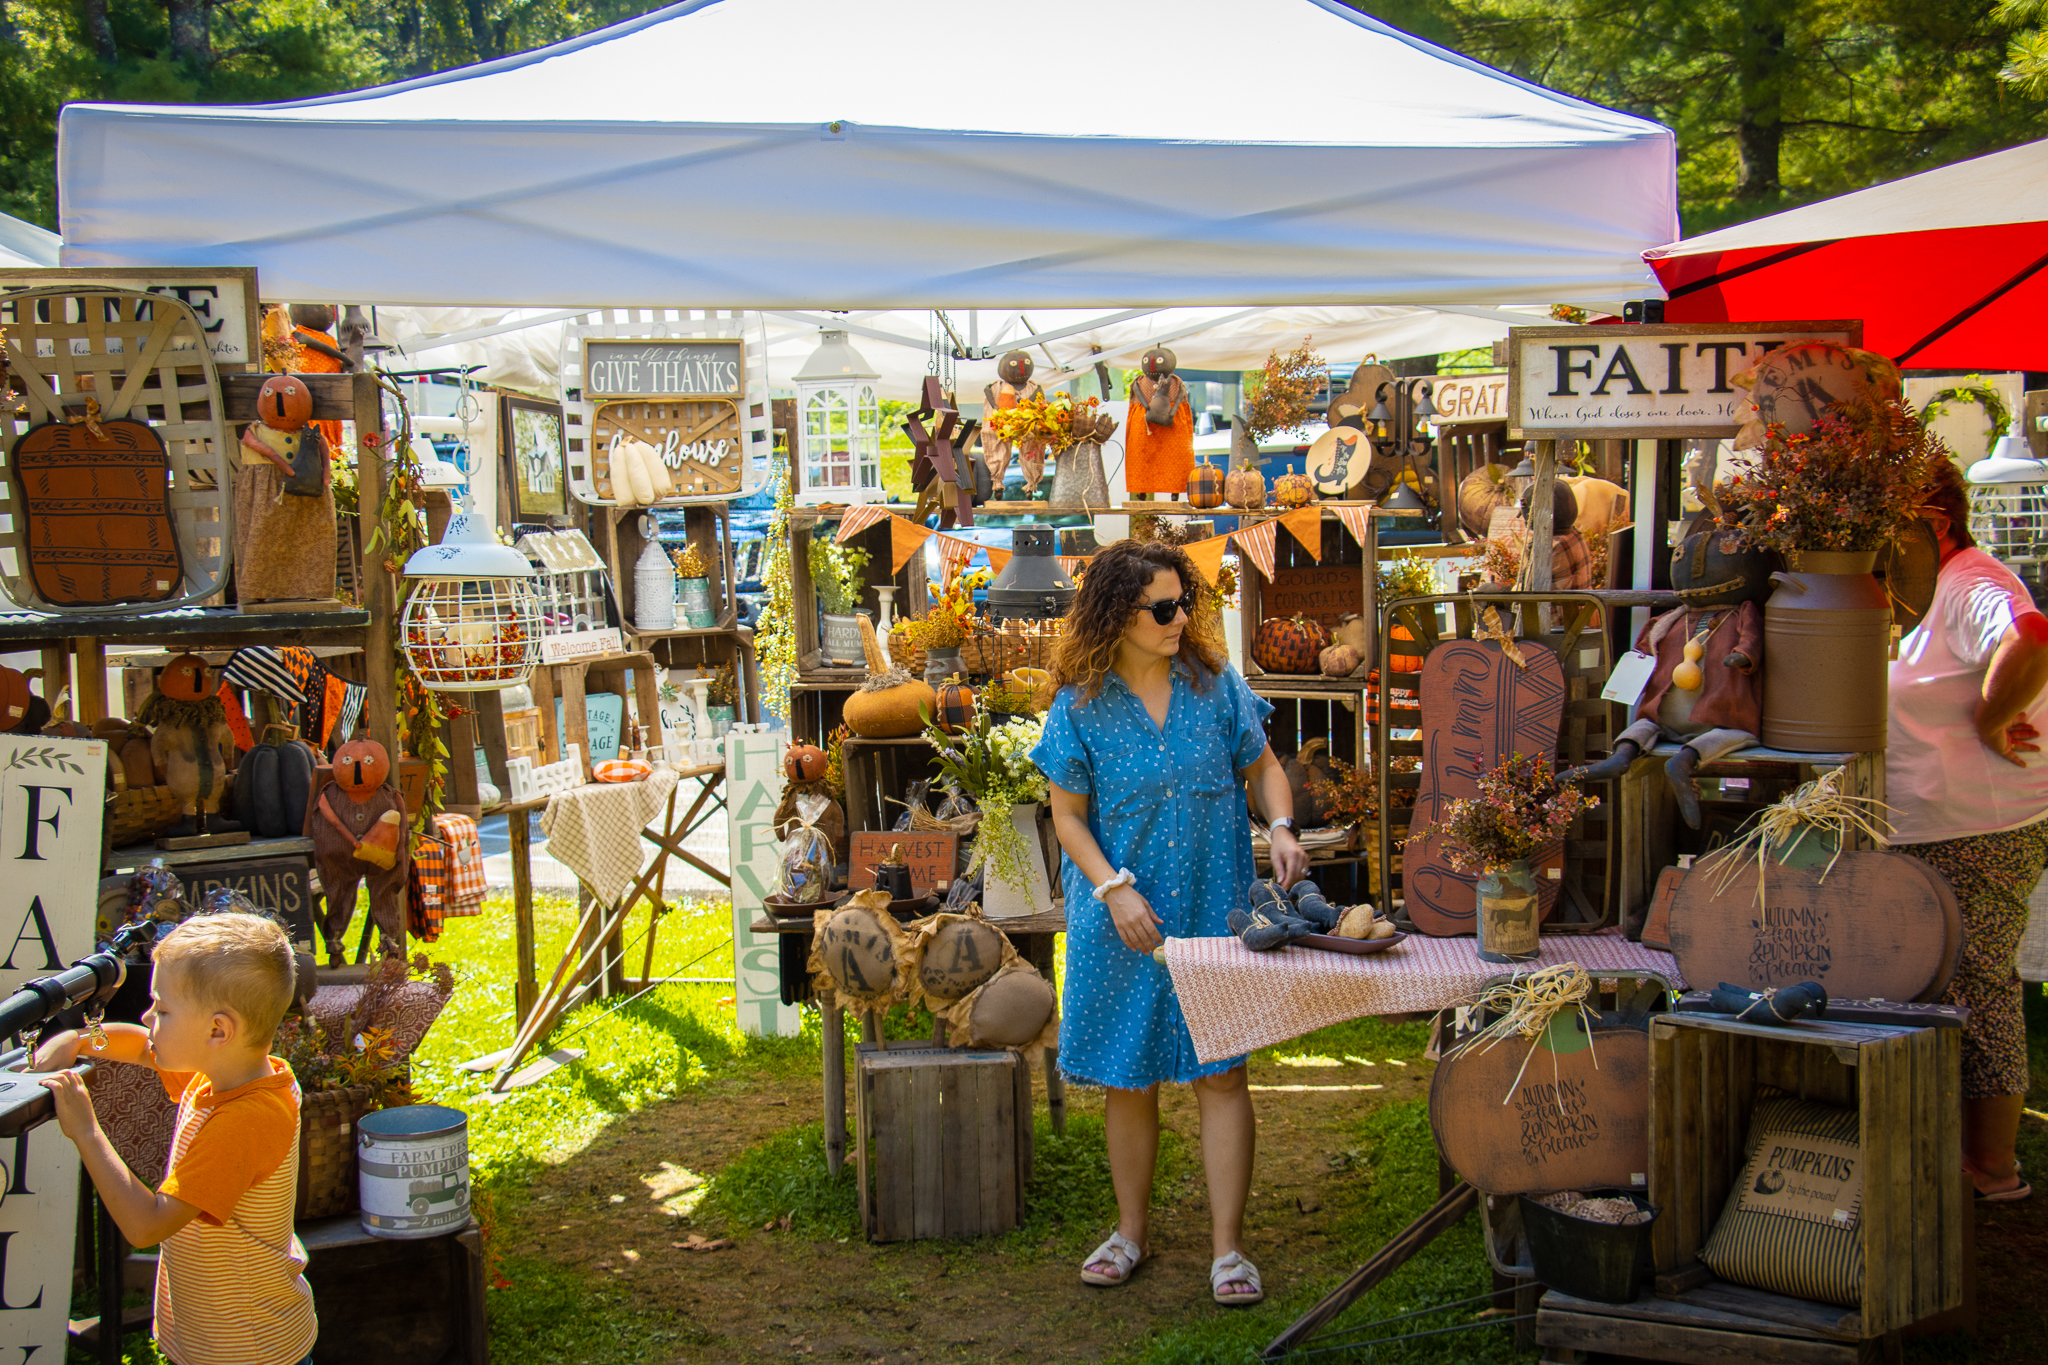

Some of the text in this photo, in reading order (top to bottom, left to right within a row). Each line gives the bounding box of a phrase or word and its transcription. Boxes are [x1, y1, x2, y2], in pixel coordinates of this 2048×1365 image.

[609, 347, 719, 365] in all things
[590, 360, 739, 393] GIVE THANKS
[1548, 341, 1786, 397] FAIT
[1437, 383, 1508, 418] GRAT
[1527, 405, 1570, 421] When
[1576, 405, 1604, 424] God
[1609, 404, 1641, 419] closes
[1647, 409, 1671, 418] one
[1277, 571, 1351, 587] GOURDS
[1274, 590, 1355, 610] CORNSTALKS
[827, 626, 861, 639] HARDY
[550, 635, 620, 657] Welcome Fall
[859, 839, 945, 859] HAVEST
[868, 863, 937, 883] TME
[181, 871, 301, 913] MPKINS
[1769, 925, 1819, 943] leaves
[1761, 959, 1819, 982] please
[1523, 1078, 1576, 1107] AUTUMN
[1533, 1099, 1580, 1122] leaves
[391, 1140, 468, 1163] FARM FRES
[1536, 1133, 1589, 1163] please
[397, 1153, 469, 1178] PUMPKIN
[1767, 1145, 1855, 1182] PUMPKINS
[1786, 1177, 1840, 1204] by the pound
[421, 1211, 461, 1227] 2 miles
